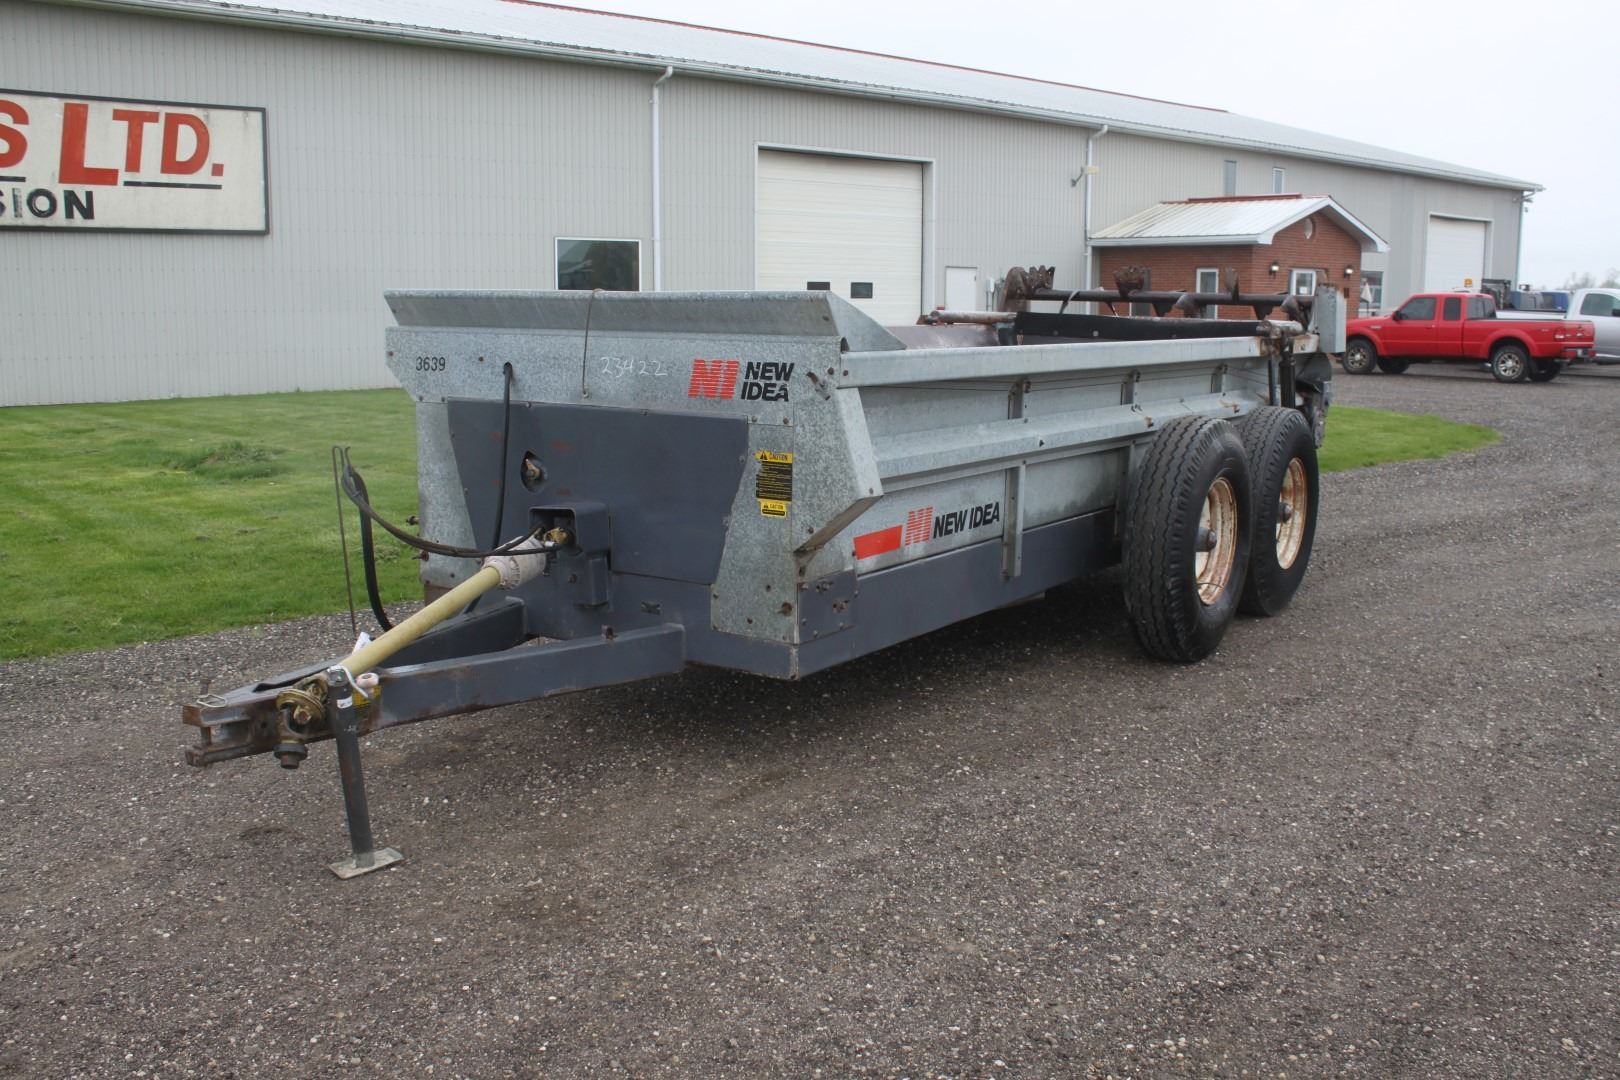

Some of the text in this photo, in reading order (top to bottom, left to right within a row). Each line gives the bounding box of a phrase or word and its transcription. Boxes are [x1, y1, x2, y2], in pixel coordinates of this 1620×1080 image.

[58, 102, 224, 186] LTD.
[0, 187, 95, 220] ION
[416, 356, 446, 372] 3639
[745, 362, 795, 381] NEW
[741, 382, 789, 402] IDEA
[933, 509, 968, 539] NEW
[969, 502, 1000, 529] IDEA
